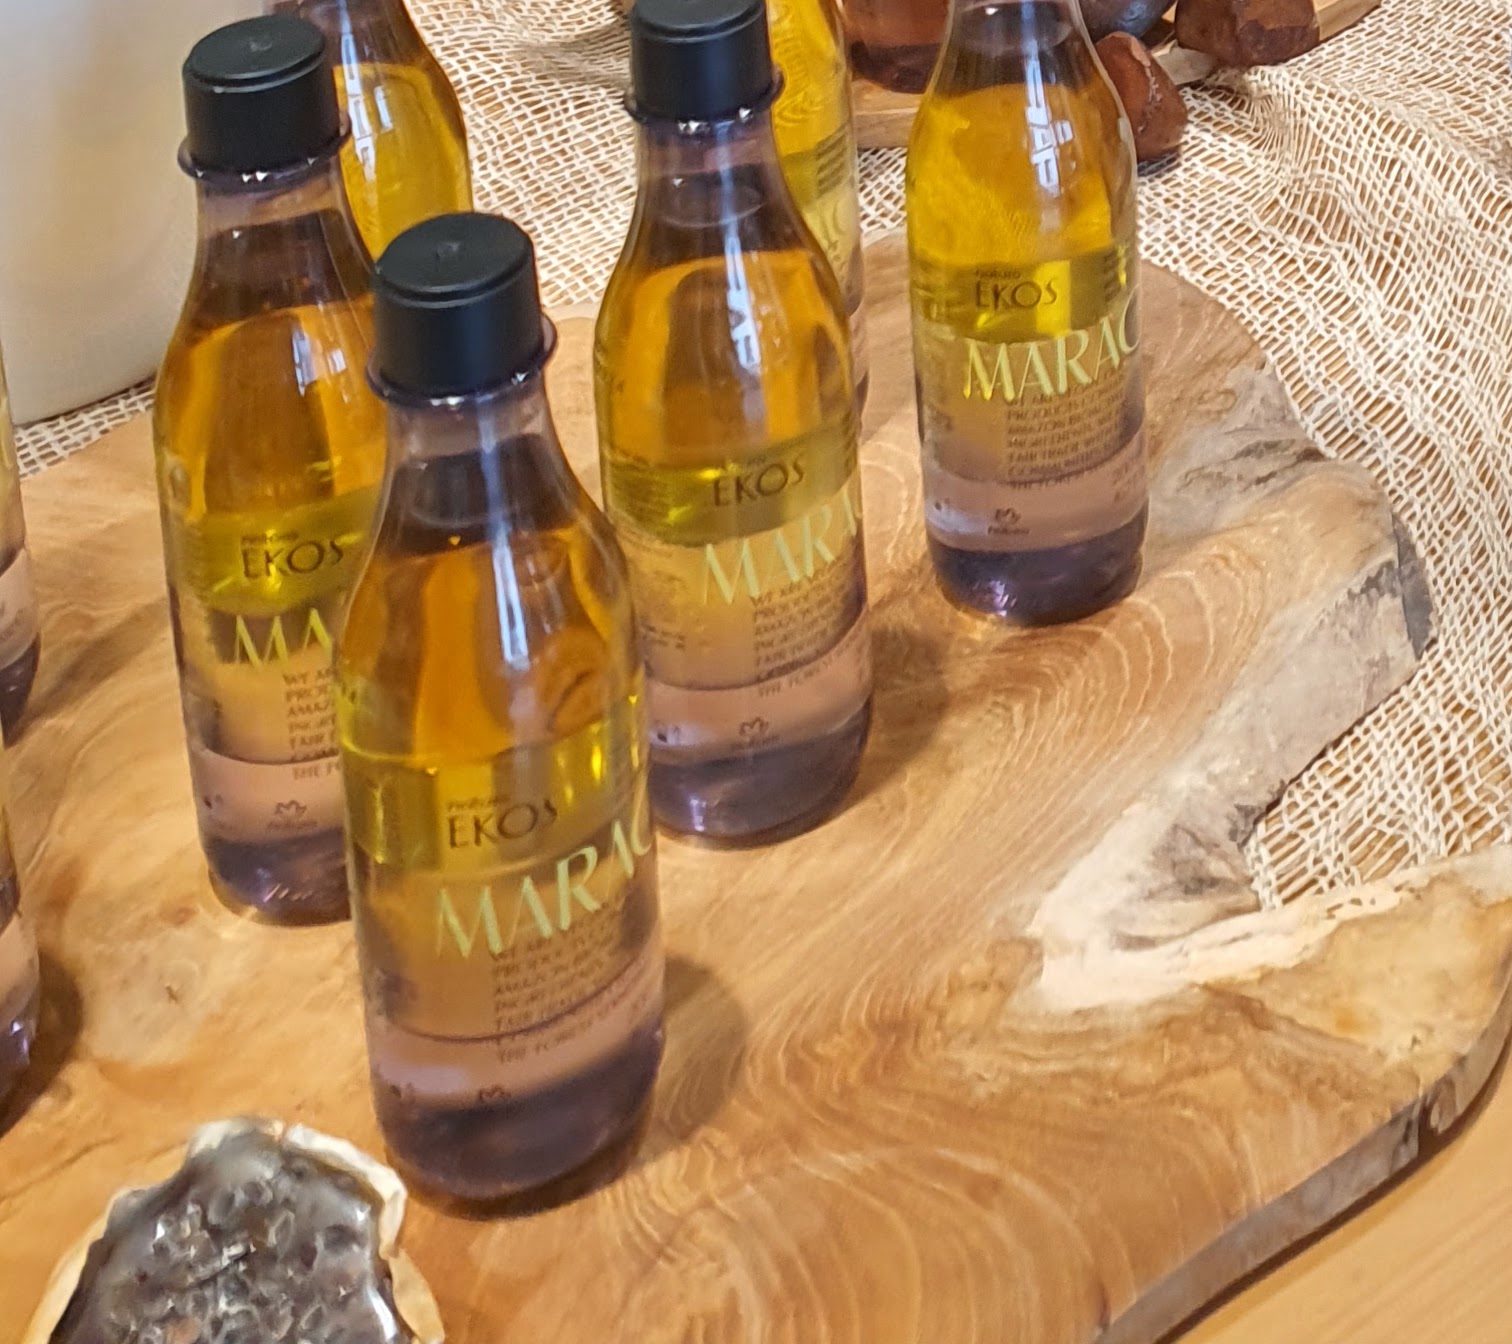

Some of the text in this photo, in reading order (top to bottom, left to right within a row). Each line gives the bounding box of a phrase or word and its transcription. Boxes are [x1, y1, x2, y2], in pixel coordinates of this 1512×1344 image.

[975, 280, 1058, 310] EKOS
[714, 463, 805, 506] EKOS
[242, 540, 343, 579] EKOS
[448, 800, 557, 848] EKOS
